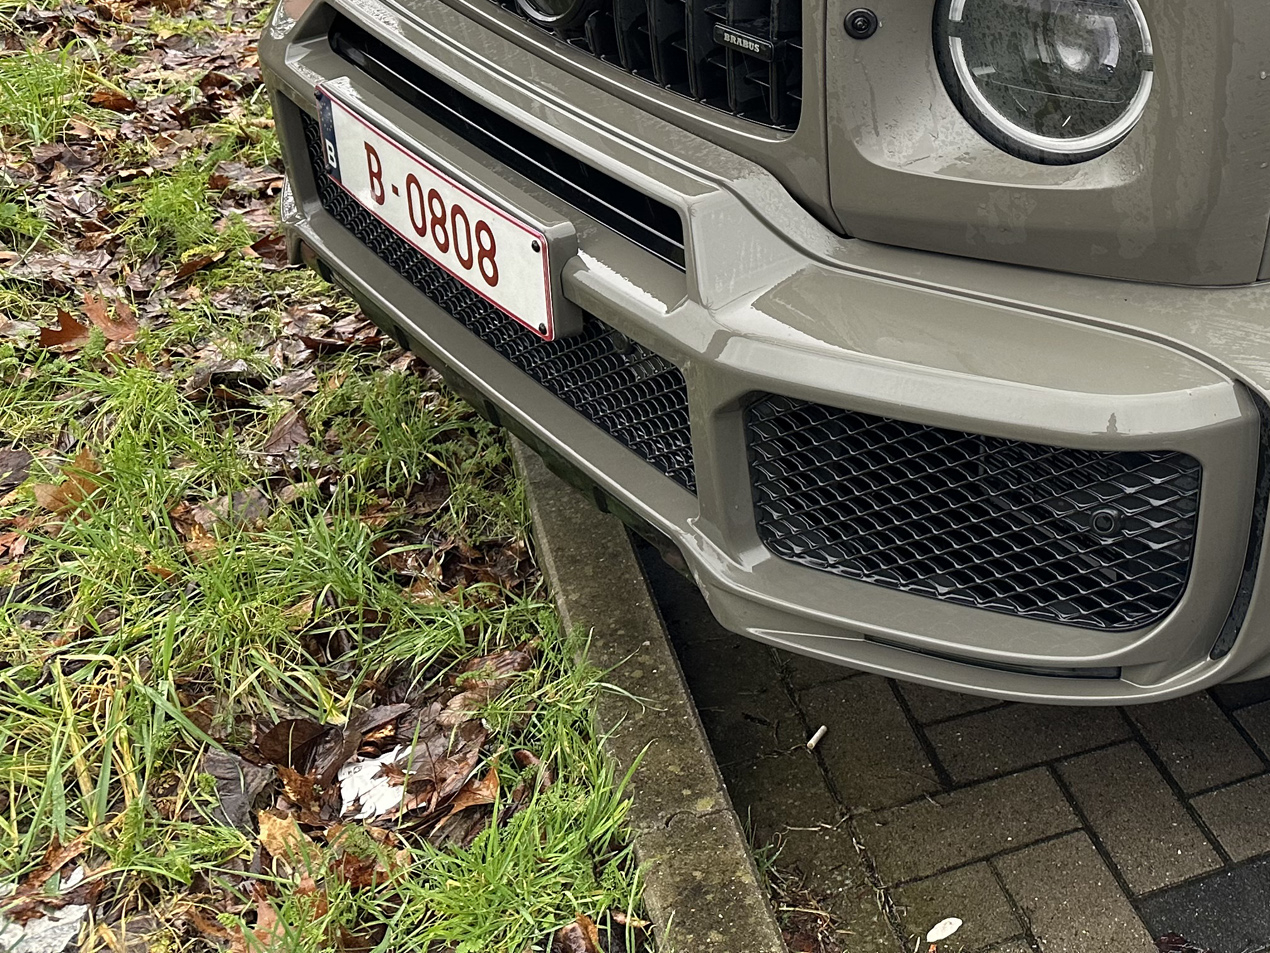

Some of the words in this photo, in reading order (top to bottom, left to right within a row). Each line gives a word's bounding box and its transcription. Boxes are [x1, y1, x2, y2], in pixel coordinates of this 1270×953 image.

[723, 32, 760, 53] BRABUS
[325, 138, 336, 169] B
[364, 141, 499, 287] B-0808
